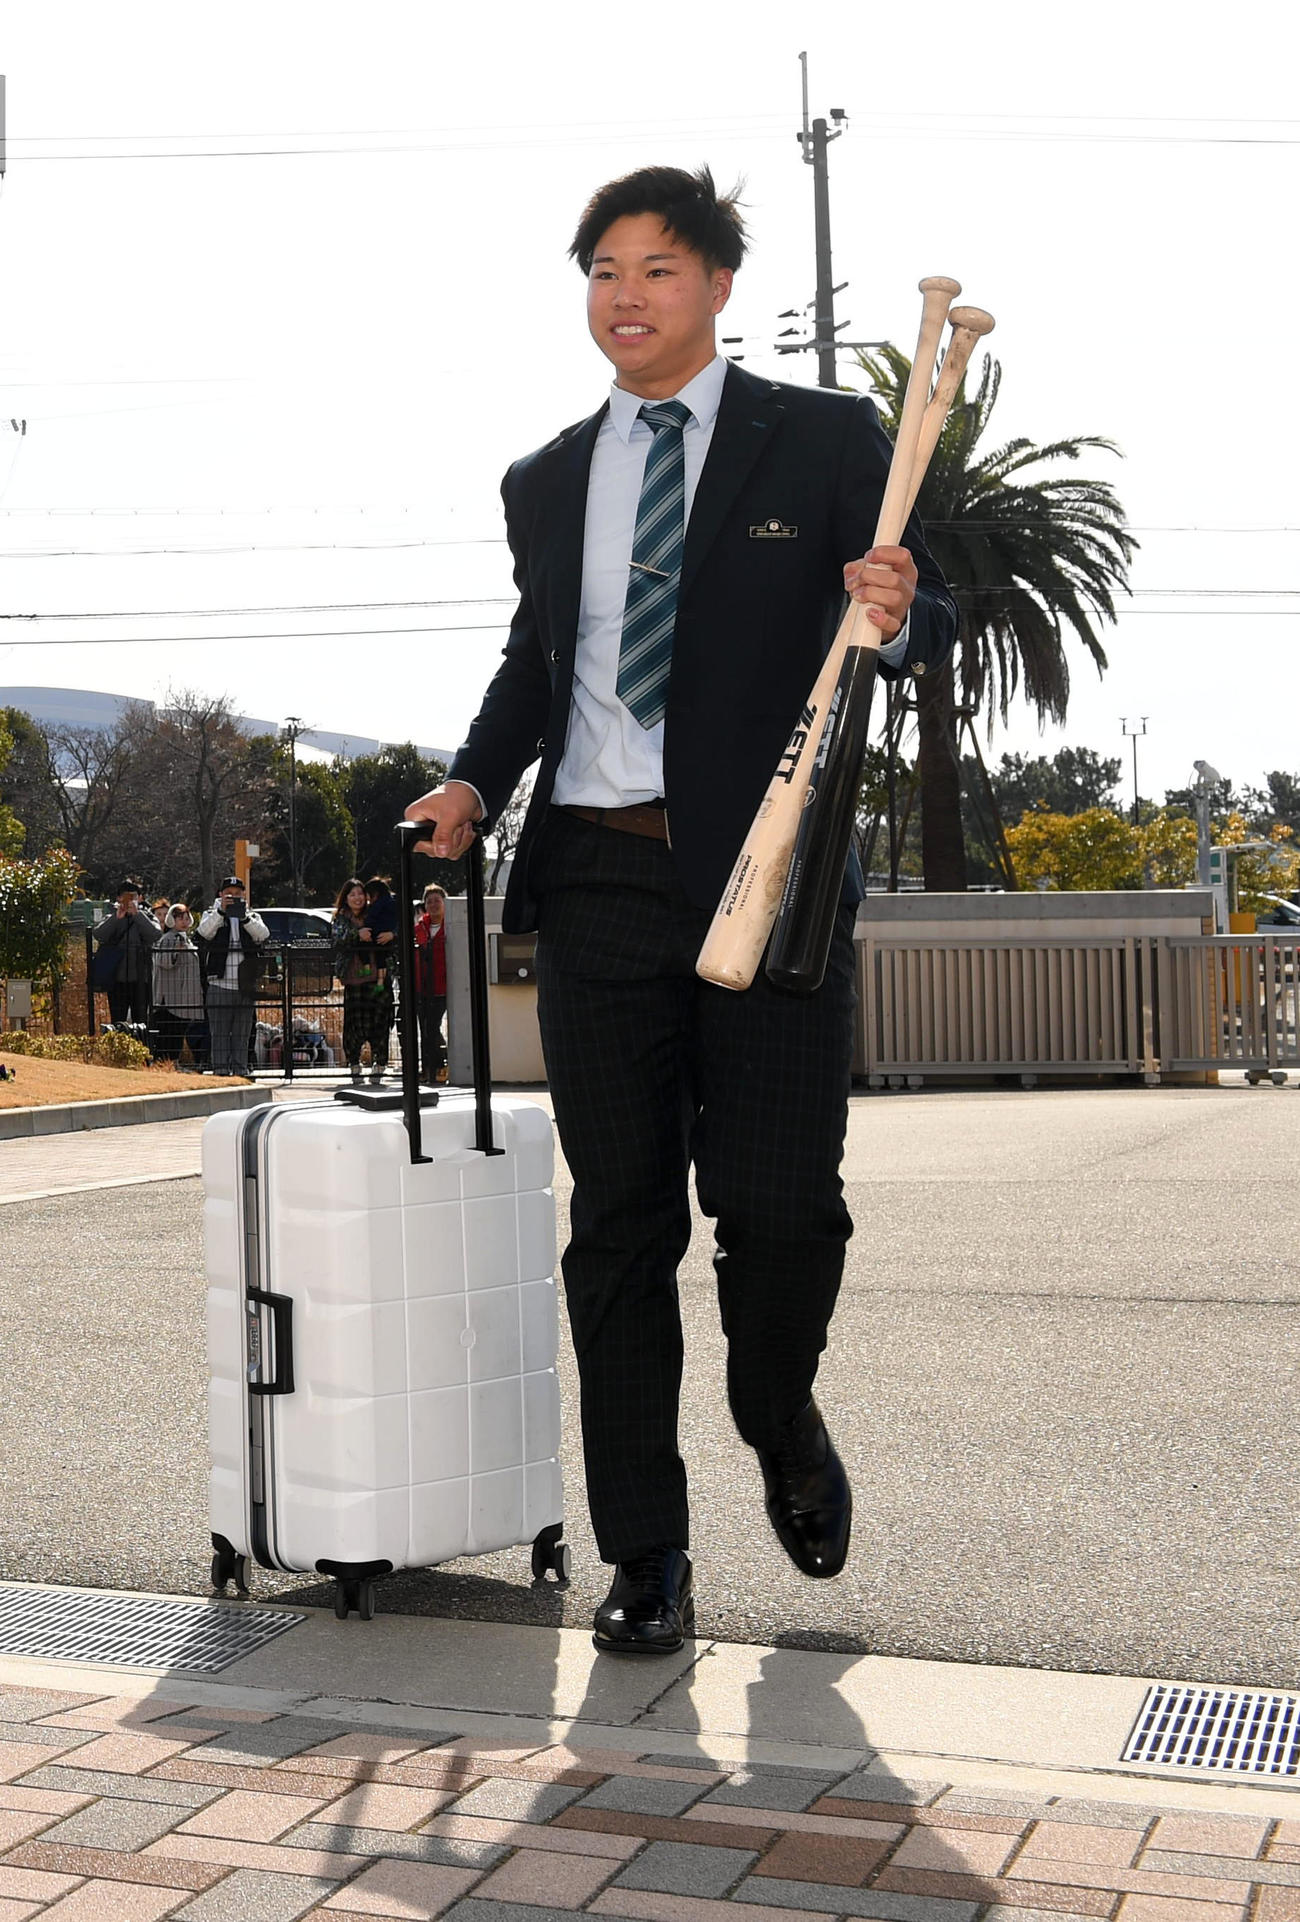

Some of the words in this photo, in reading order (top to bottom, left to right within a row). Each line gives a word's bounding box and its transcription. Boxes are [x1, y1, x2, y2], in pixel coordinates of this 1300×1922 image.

[775, 704, 817, 784] ZETT
[726, 854, 752, 917] PROSTATUS
[738, 864, 758, 910] PROFESSIONAL
[787, 860, 802, 908] PROFESSIONAL
